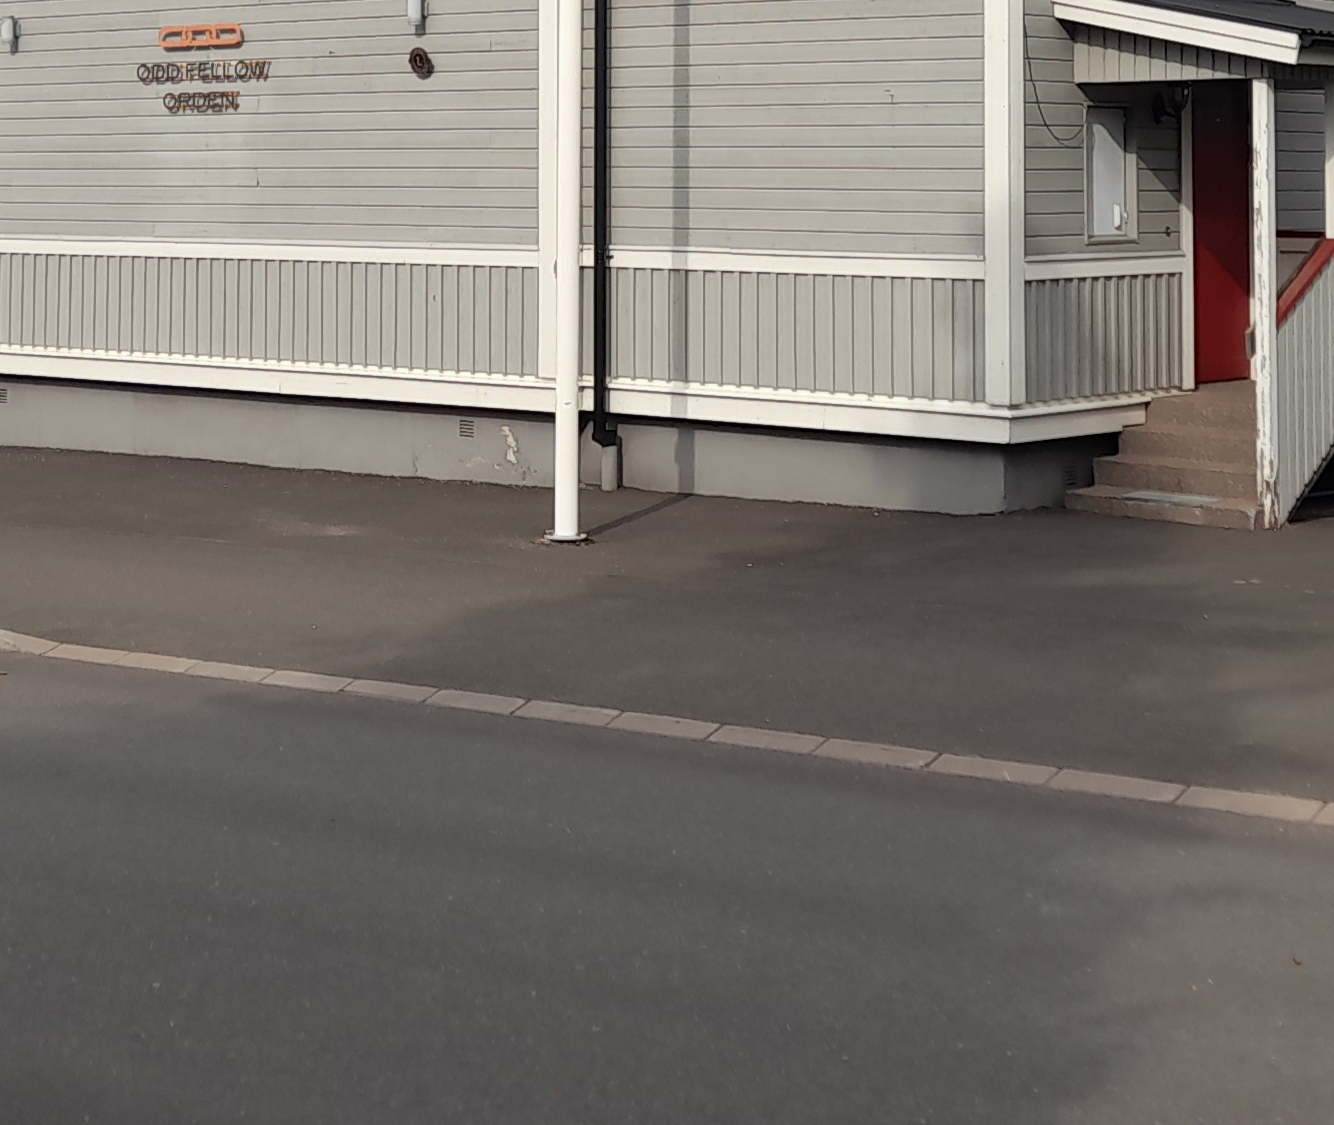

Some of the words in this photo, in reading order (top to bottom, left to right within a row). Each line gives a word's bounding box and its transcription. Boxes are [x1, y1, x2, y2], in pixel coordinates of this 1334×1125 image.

[136, 62, 181, 82] ODD
[185, 59, 270, 80] FELLOW
[162, 91, 239, 111] ORDEN
